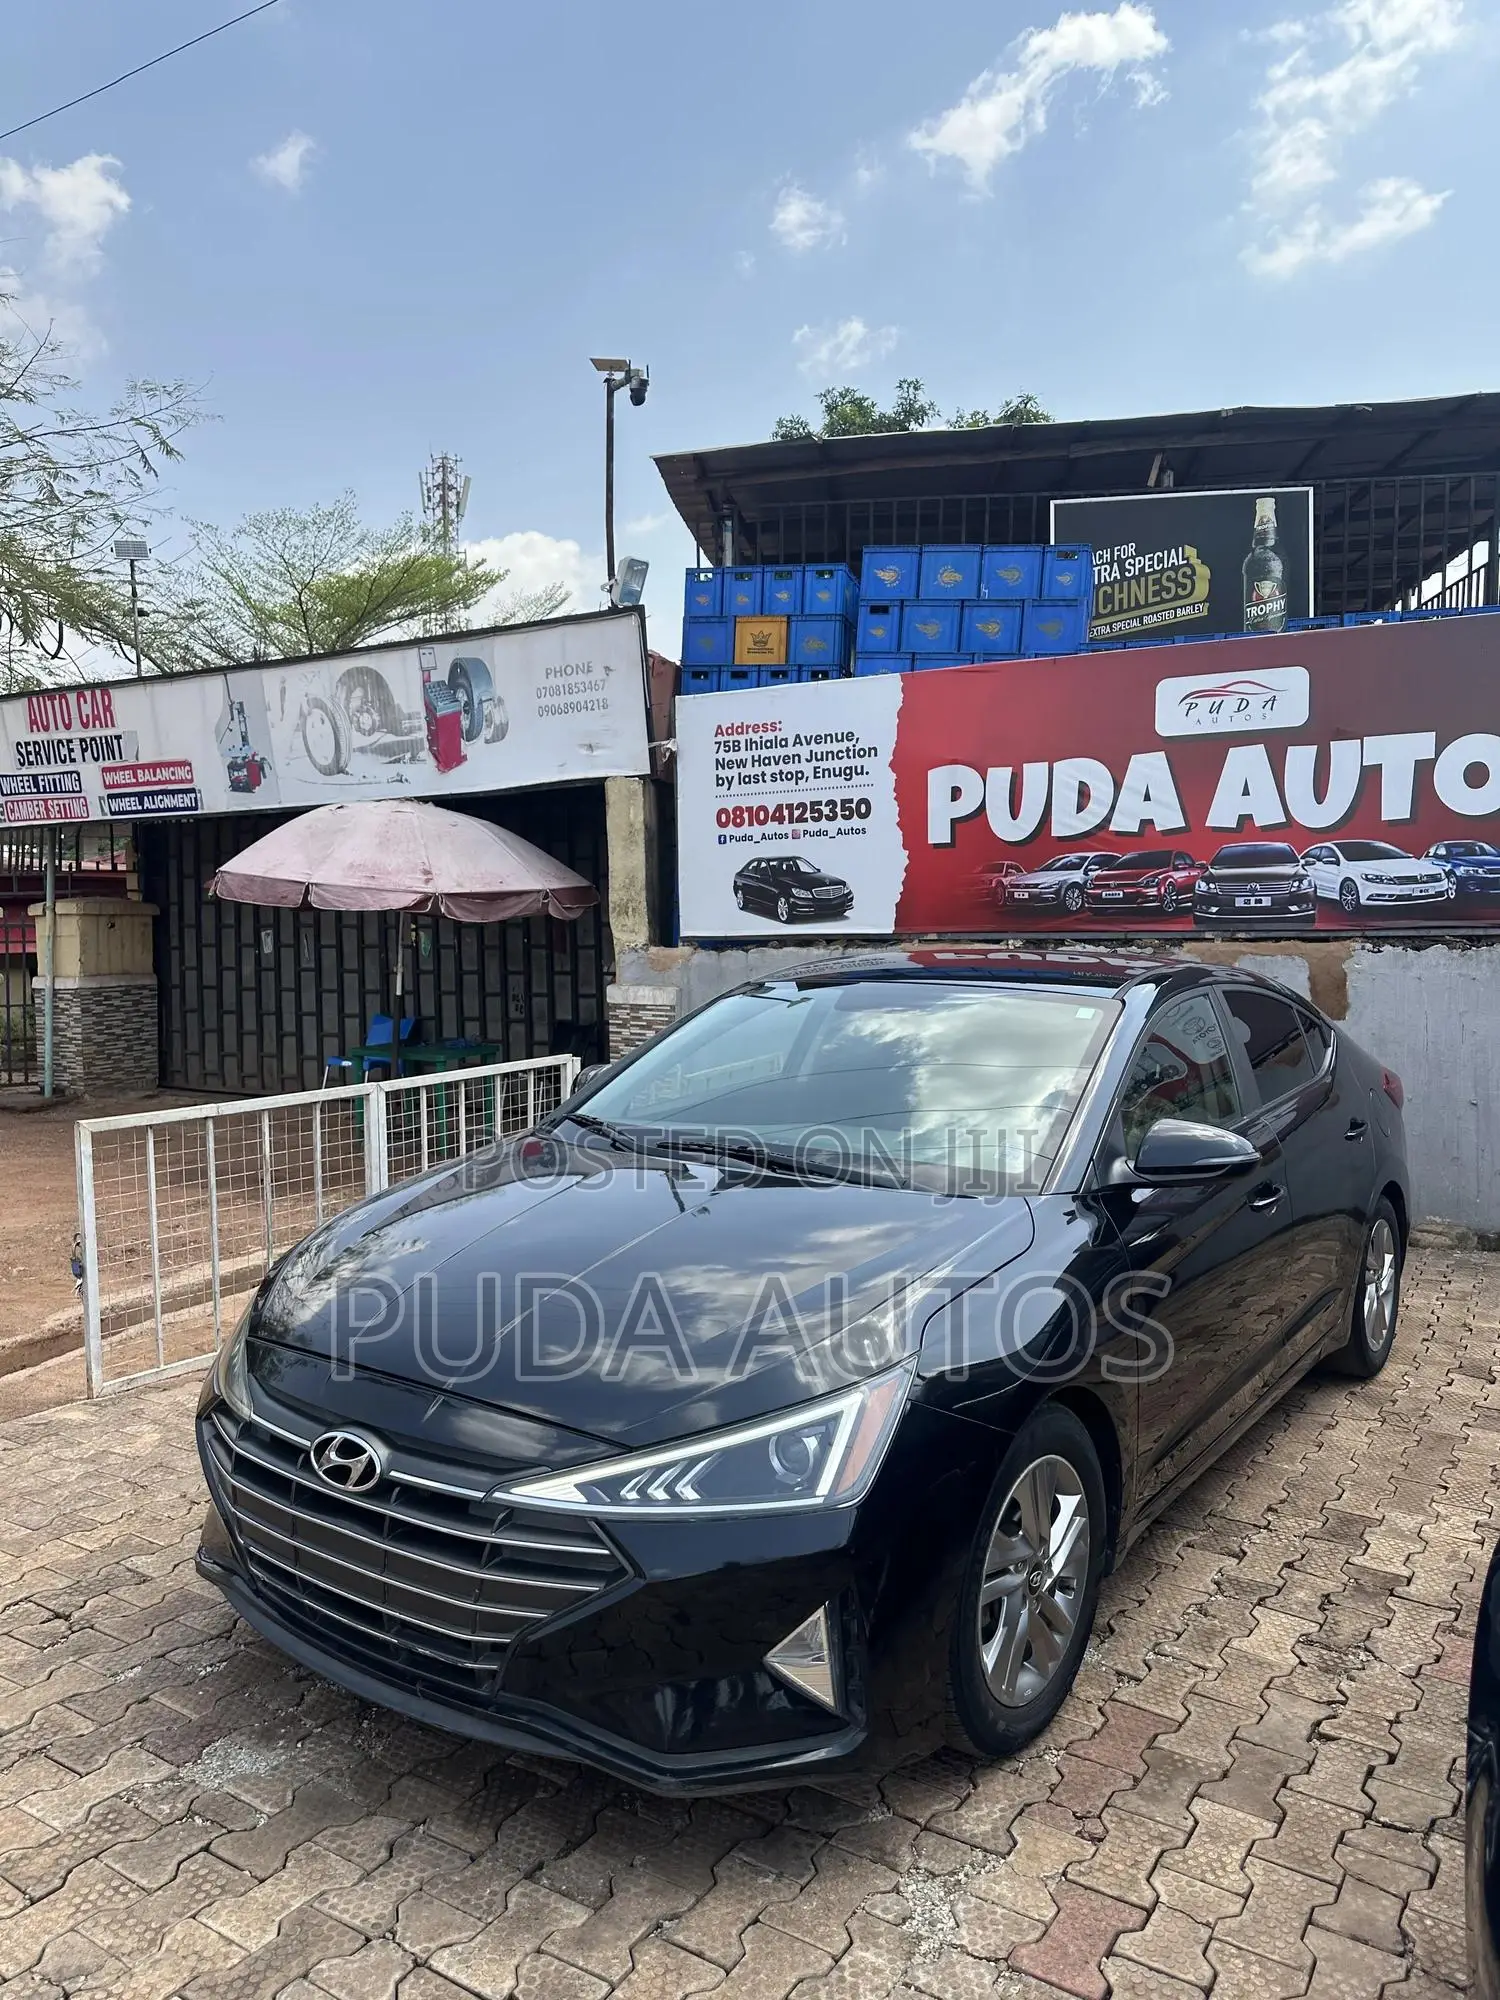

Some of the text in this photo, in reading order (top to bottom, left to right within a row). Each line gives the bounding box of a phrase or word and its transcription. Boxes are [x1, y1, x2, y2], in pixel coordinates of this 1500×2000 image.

[1114, 542, 1137, 562] FOR
[1124, 546, 1187, 579] SPECIAL
[1246, 599, 1286, 618] TROPHY
[1089, 602, 1204, 639] EXTRA SPECIAL ROASTED BARLEY
[545, 660, 593, 679] PHONE
[536, 678, 606, 699] 07081853467
[26, 688, 116, 733] AUTO CAR
[537, 697, 609, 718] 09068904218
[1185, 695, 1277, 717] PUDA
[714, 720, 783, 738] Address:
[1195, 712, 1267, 725] AUTOS
[15, 734, 124, 768] SERVICE POINT
[714, 730, 860, 755] 75B Ihiala Avenue,
[715, 744, 878, 771] New Haven Junction
[0, 772, 81, 795] WHEEL FITTING
[103, 765, 192, 786] WHEEL BALANCING
[716, 764, 870, 791] by last stop, Enugu.
[926, 731, 1500, 846] PUDA AUTO
[7, 799, 48, 822] CAMBER
[48, 797, 88, 820] SETTING
[108, 796, 142, 813] WHEEL
[143, 792, 197, 811] ALIGNMENT
[715, 797, 872, 829] 08104125350
[729, 826, 867, 845] Puda_Autos Puda_Autos
